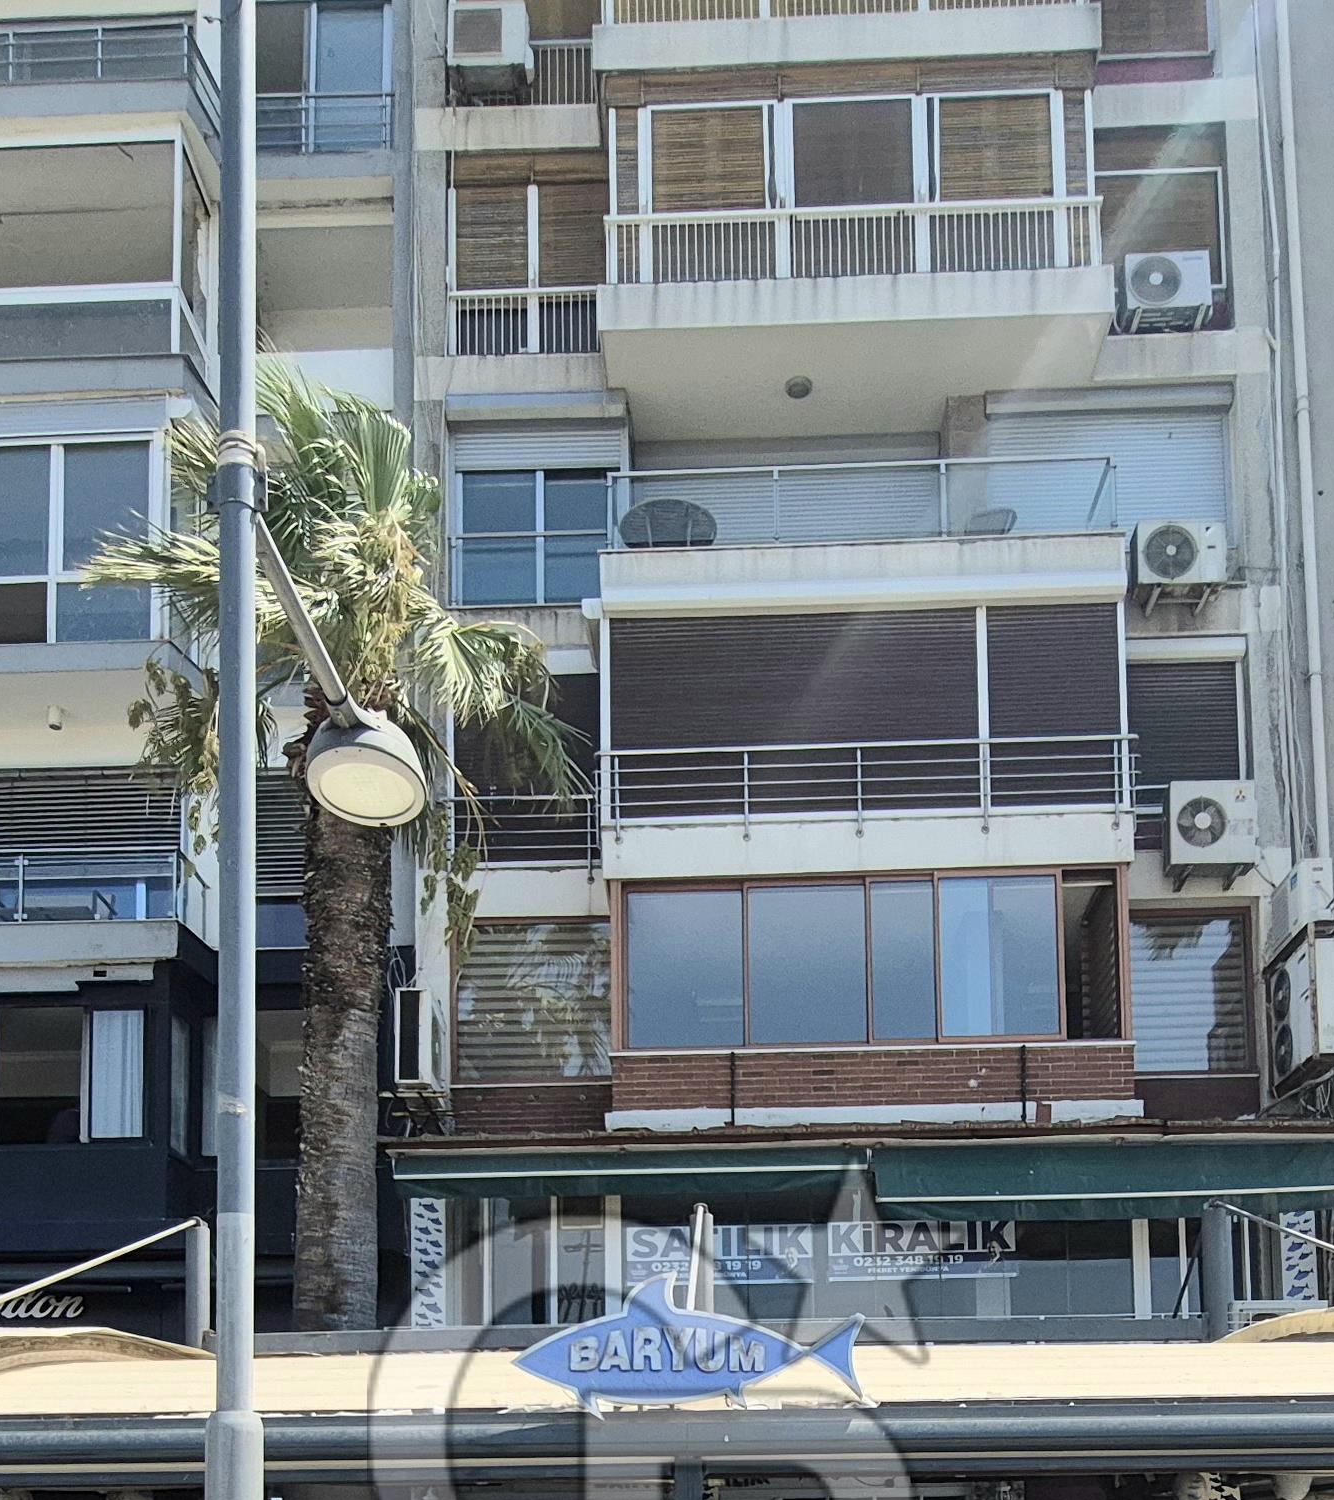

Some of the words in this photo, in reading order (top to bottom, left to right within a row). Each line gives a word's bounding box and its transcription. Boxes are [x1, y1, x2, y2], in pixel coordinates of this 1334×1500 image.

[631, 1225, 812, 1258] SAILIK
[895, 1255, 924, 1266] 348
[569, 1326, 766, 1372] BARYUM
